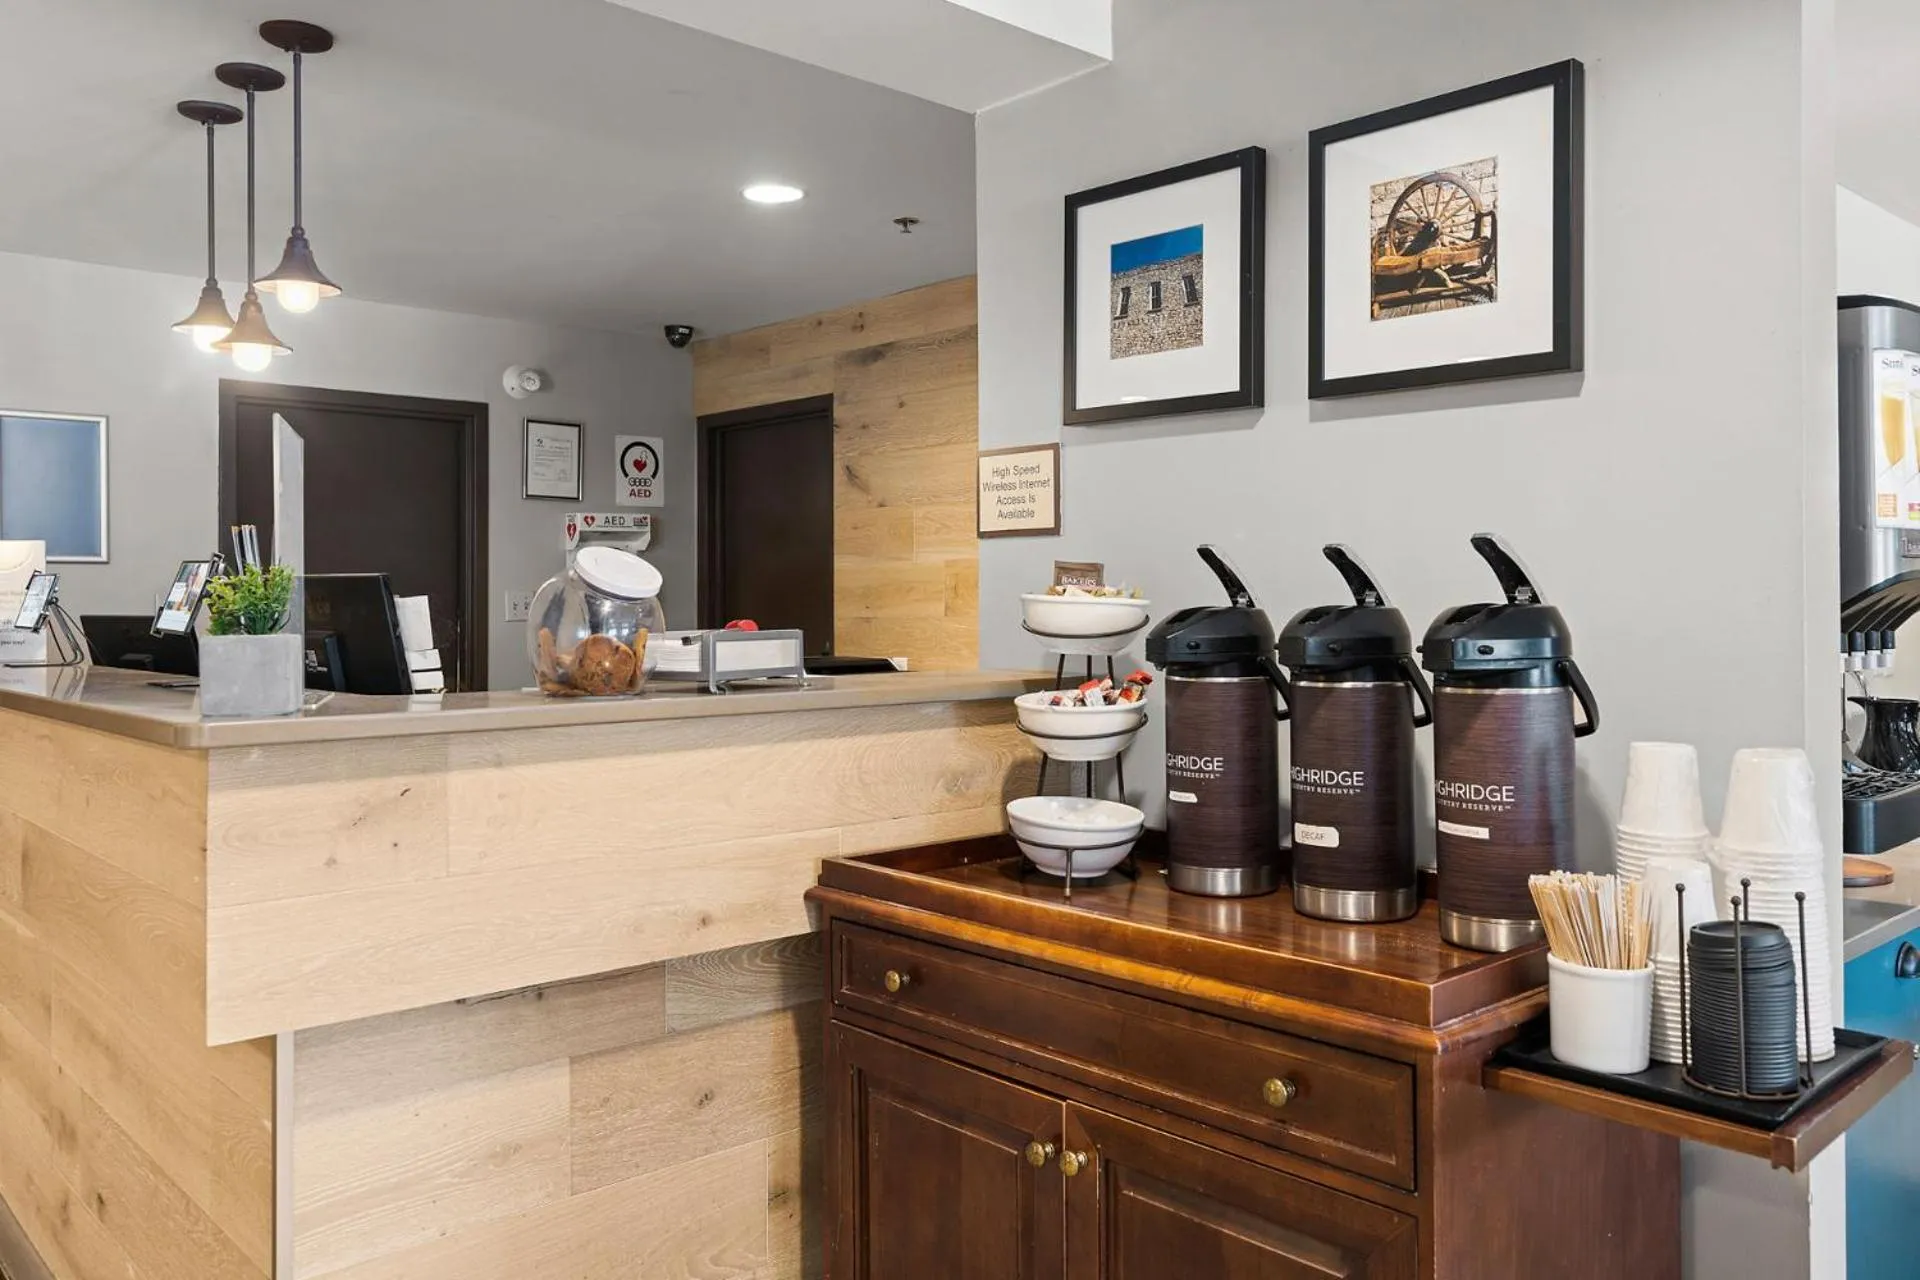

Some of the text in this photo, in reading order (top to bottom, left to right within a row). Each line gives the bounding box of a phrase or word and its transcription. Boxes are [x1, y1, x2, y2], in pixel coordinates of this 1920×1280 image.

[992, 464, 1040, 479] High Speed
[983, 478, 1050, 492] Wireless Internet
[629, 488, 652, 498] AED
[996, 495, 1026, 505] Access
[997, 508, 1035, 519] Available
[603, 516, 625, 525] AED
[1167, 753, 1224, 771] GHRIDGE
[1437, 780, 1515, 802] GHRIDGE
[1462, 802, 1504, 811] RESERVE
